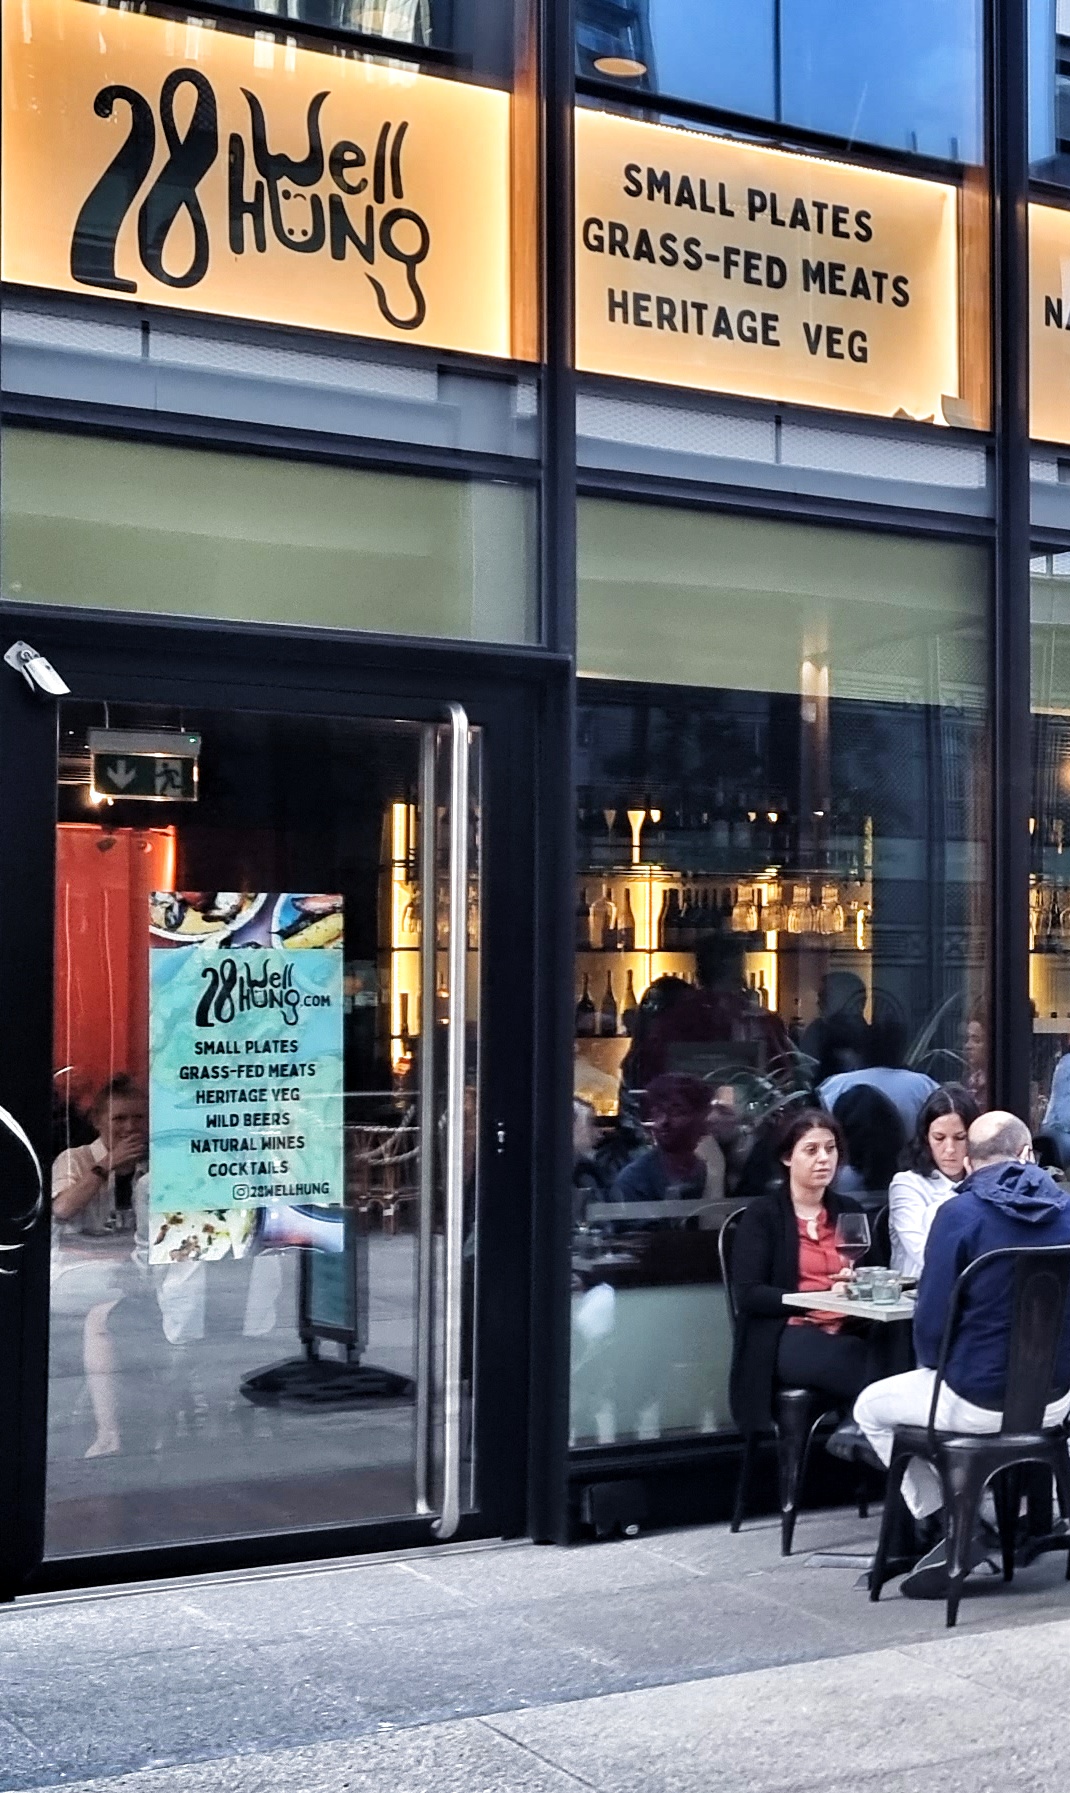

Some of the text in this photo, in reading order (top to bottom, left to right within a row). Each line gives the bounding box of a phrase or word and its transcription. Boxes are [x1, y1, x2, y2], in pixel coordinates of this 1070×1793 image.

[70, 67, 409, 294] 28 Well
[623, 162, 873, 243] SMALL PLATES
[582, 216, 910, 308] GRASS-FED MEATS
[608, 288, 868, 364] HERITAGE VEG
[195, 956, 295, 1028] 28 Well
[194, 1039, 299, 1055] SMALL PLATES
[179, 1062, 316, 1080] GRASS-FED MEATS
[196, 1087, 301, 1104] HERITAGE VEG
[206, 1112, 290, 1128] WILD BEERS
[191, 1135, 305, 1154] NATURAL WINES
[208, 1160, 289, 1177] COCKTAILS
